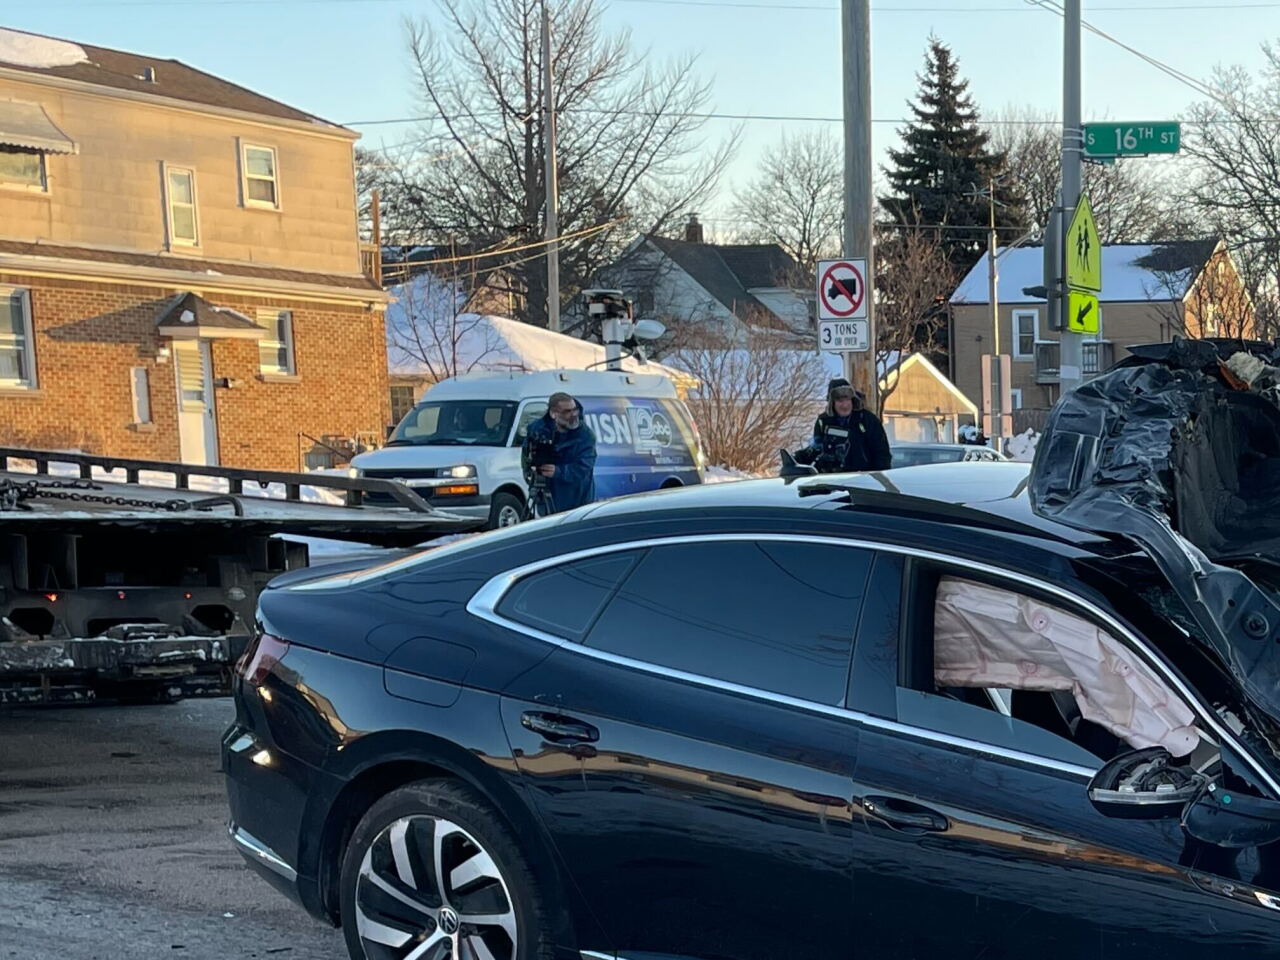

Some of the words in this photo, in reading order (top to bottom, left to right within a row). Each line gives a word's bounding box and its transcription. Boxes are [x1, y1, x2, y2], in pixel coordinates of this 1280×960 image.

[1087, 133, 1095, 145] S
[1160, 132, 1175, 144] ST
[823, 327, 832, 344] 3
[834, 323, 857, 335] TONS
[834, 337, 842, 346] OR
[844, 337, 857, 346] OVER
[653, 421, 671, 435] abc
